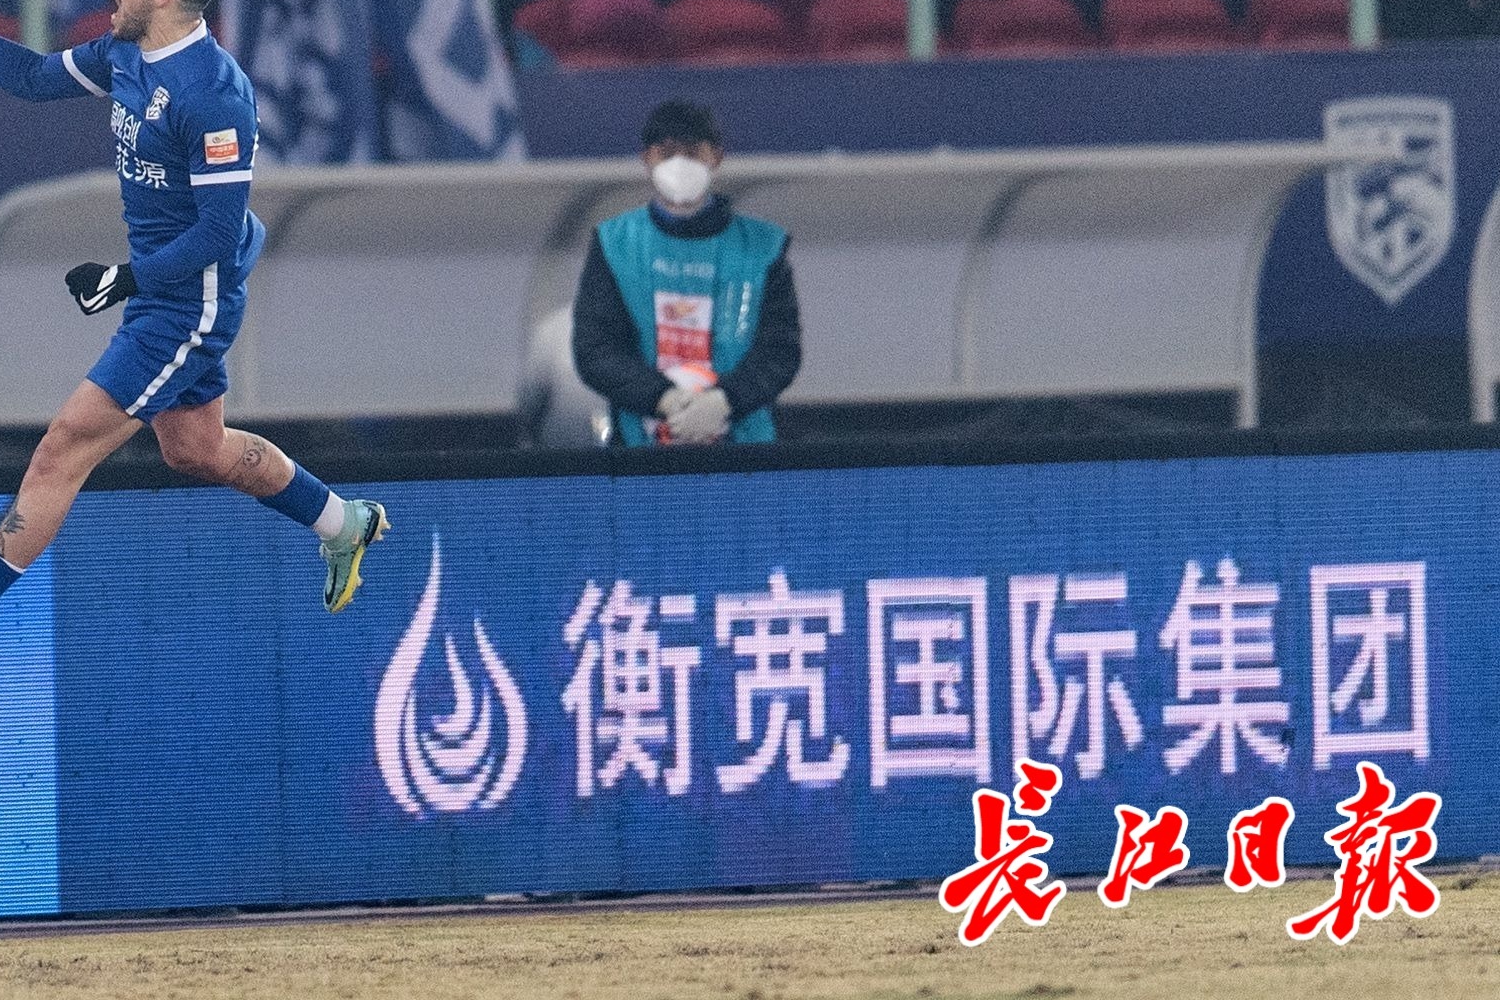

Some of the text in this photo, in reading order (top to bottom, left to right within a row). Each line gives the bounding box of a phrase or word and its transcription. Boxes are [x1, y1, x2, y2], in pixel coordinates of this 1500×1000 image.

[561, 558, 1431, 797] 衡宽国际集团
